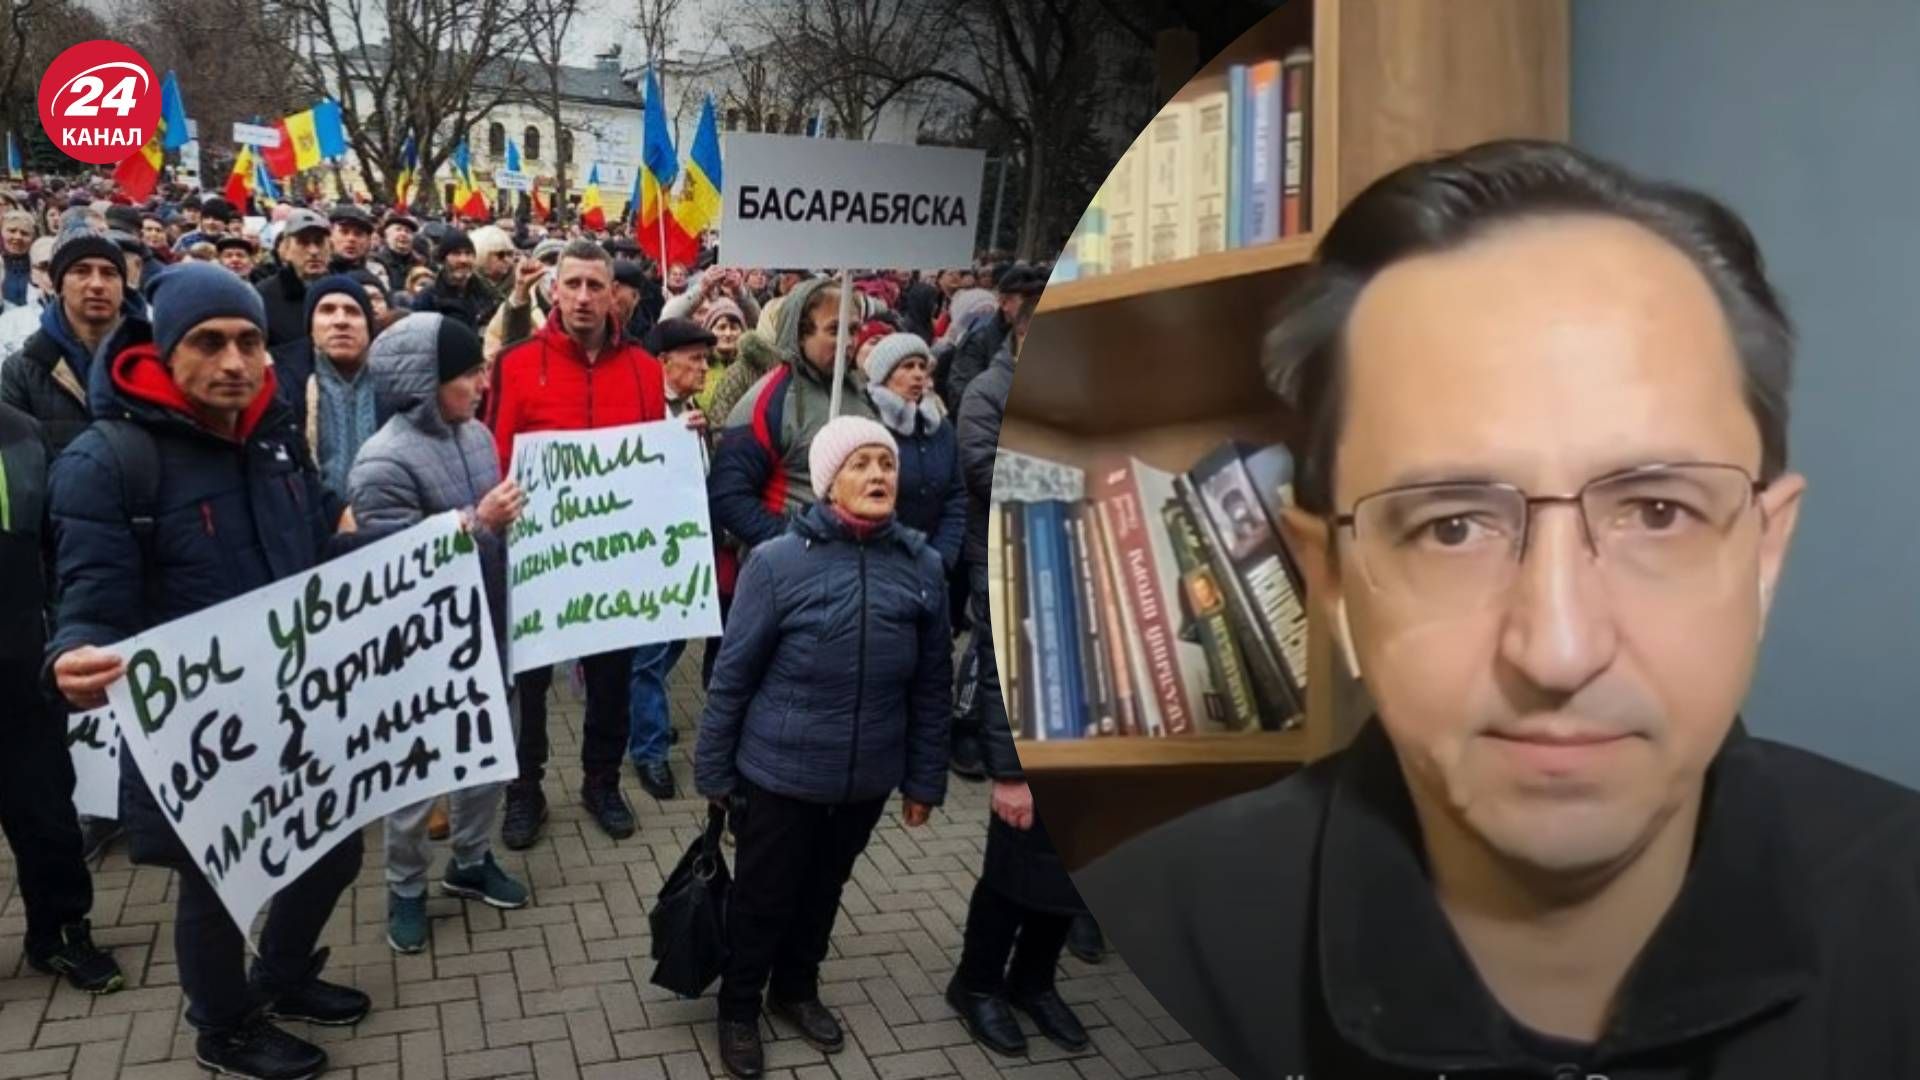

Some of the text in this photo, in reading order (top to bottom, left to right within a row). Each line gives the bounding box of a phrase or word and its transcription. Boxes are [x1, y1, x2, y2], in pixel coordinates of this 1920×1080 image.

[738, 185, 968, 227] БАСАРАБЯСКА
[661, 521, 708, 568] за
[127, 636, 245, 738] Вы
[159, 584, 482, 824] себе зарплату
